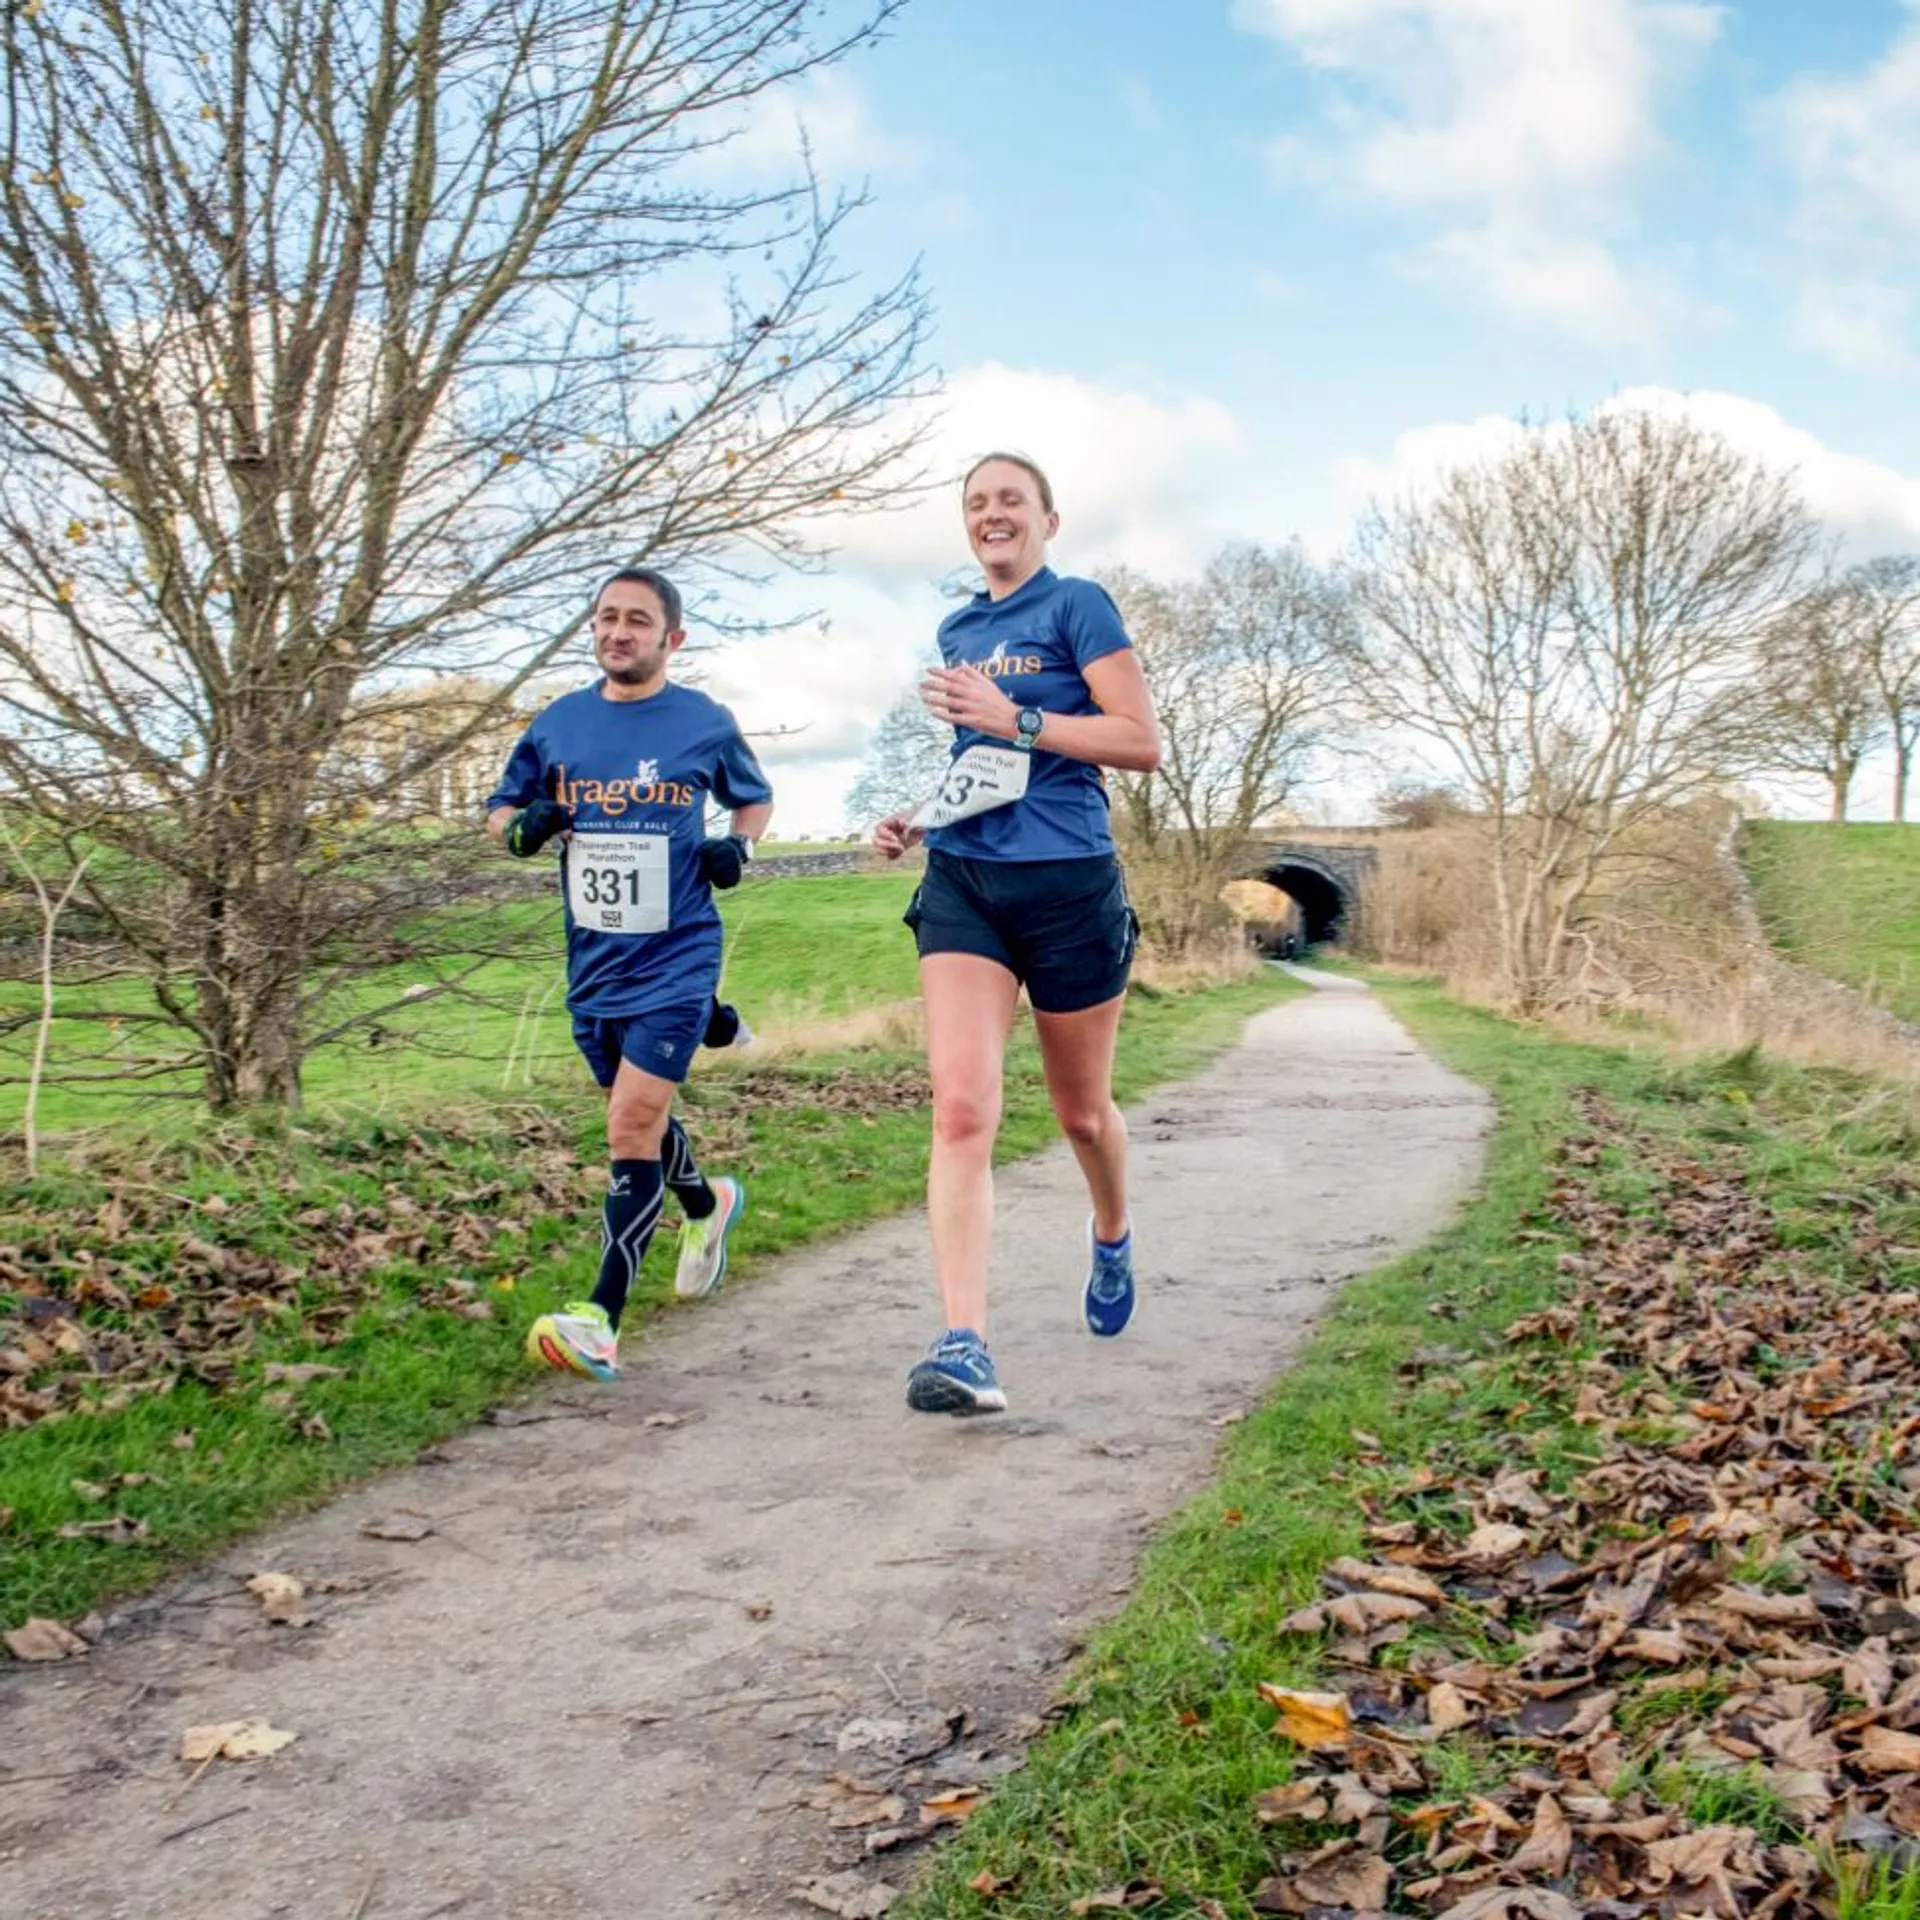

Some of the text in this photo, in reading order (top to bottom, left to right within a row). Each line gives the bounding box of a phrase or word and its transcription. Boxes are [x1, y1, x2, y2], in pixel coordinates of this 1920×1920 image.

[572, 821, 612, 830] UNNING
[587, 853, 636, 862] Marathon
[582, 868, 639, 906] 331
